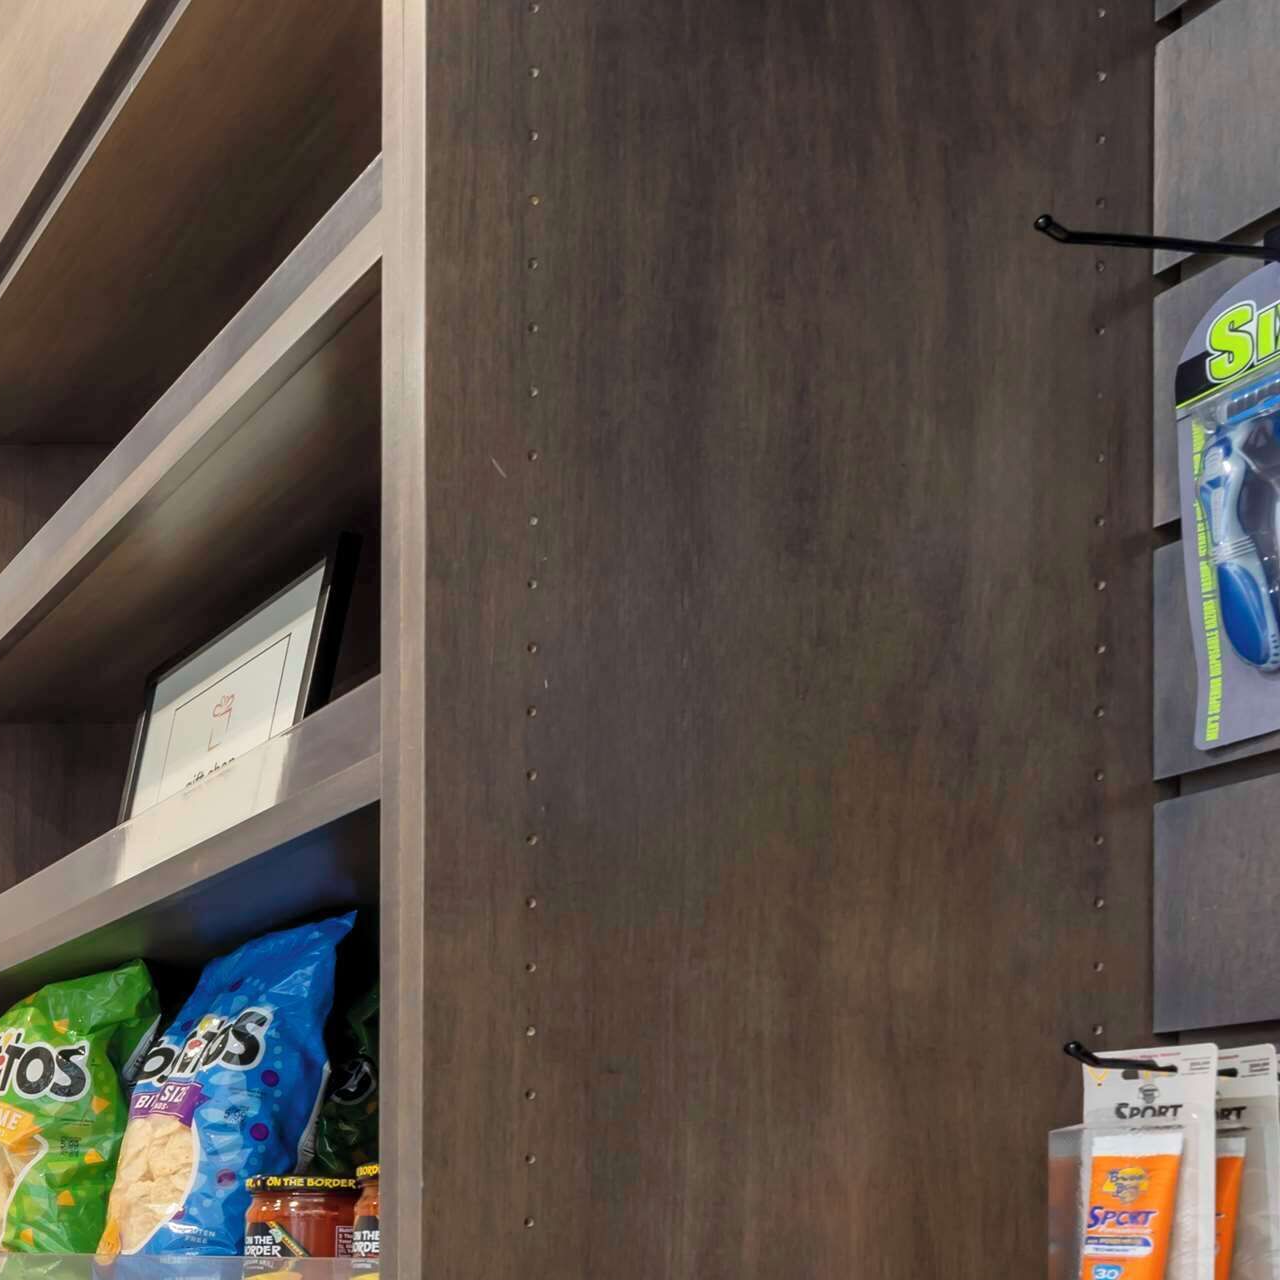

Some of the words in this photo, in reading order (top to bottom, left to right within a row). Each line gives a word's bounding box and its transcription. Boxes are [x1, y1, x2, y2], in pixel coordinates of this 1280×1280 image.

[266, 1176, 278, 1187] ON
[282, 1177, 305, 1187] THE
[306, 1177, 357, 1189] BORDER
[253, 1235, 274, 1245] THE
[1095, 1268, 1120, 1280] 30
